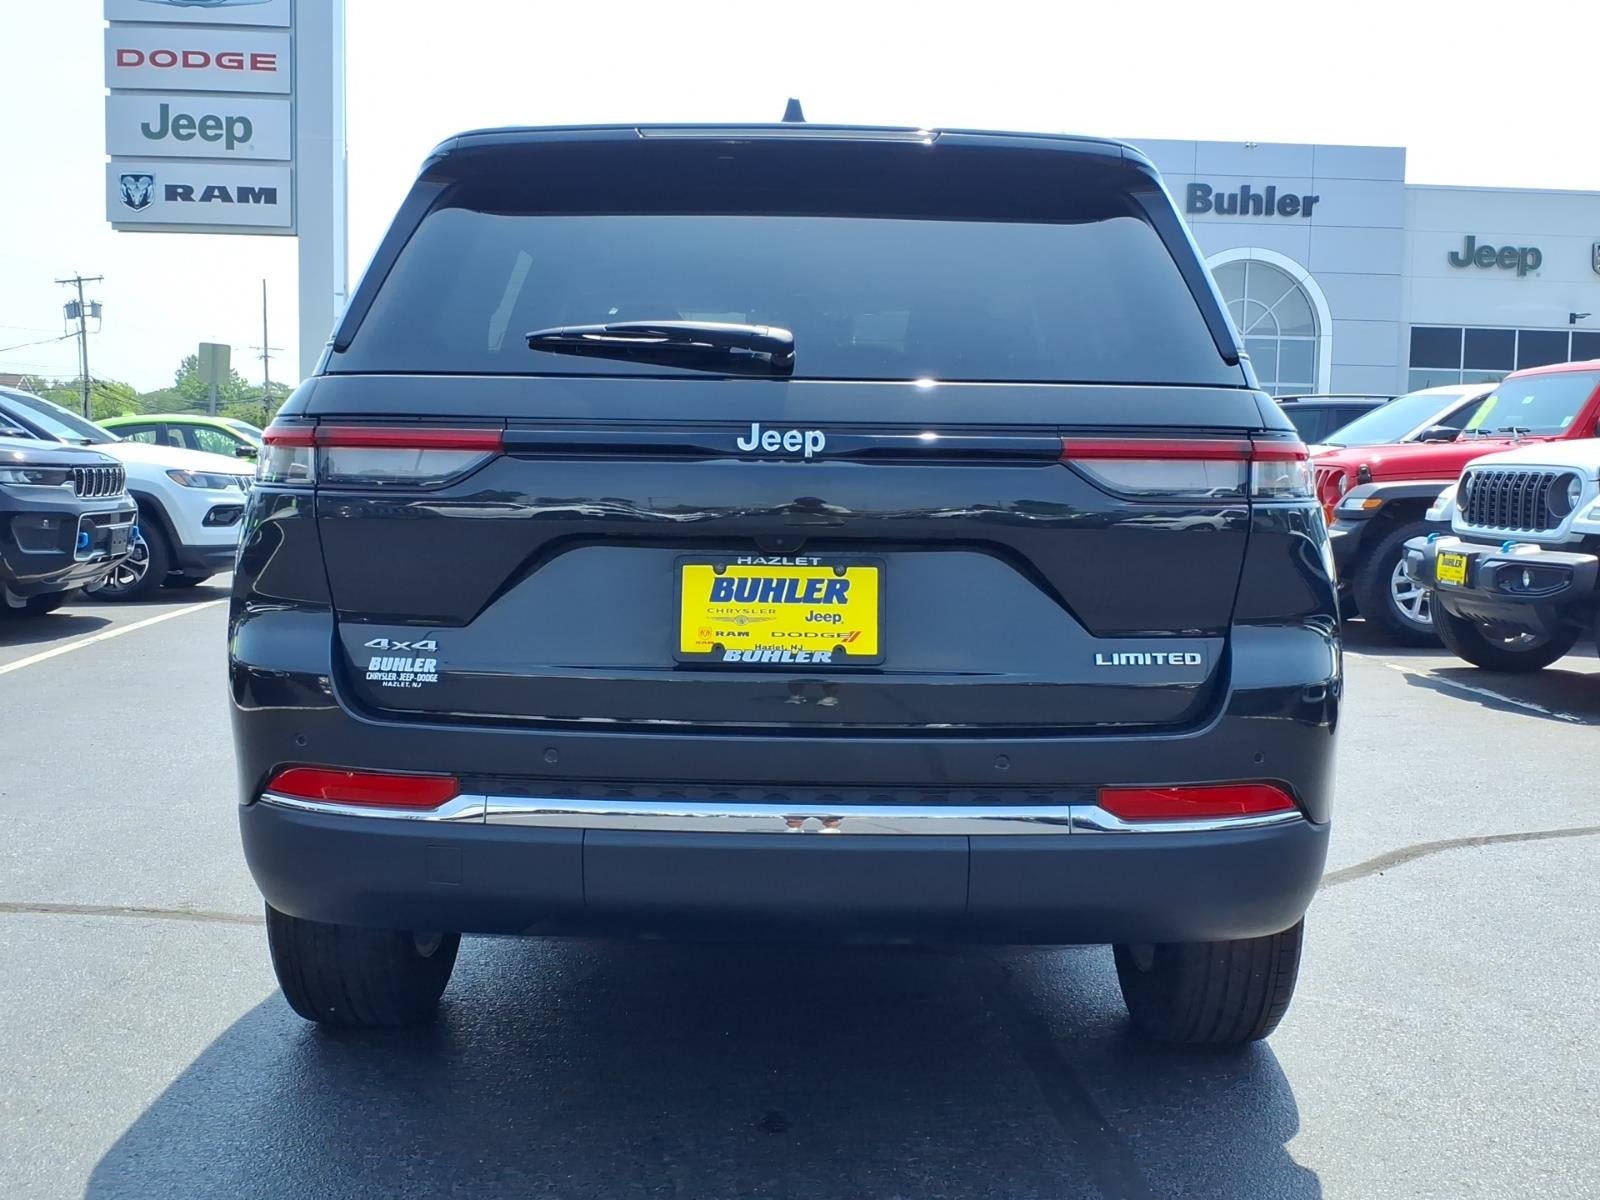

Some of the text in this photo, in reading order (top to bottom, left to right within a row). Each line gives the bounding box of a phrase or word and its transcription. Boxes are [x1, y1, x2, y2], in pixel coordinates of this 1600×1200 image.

[116, 48, 277, 72] DODGE
[140, 103, 253, 151] Jeep
[164, 184, 278, 205] RAM
[1186, 183, 1320, 217] Buhler
[1448, 235, 1542, 276] Jeep
[736, 423, 826, 458] Jeep
[737, 556, 821, 566] HAZLET
[709, 577, 850, 604] BUHLER
[805, 610, 842, 624] Jeep
[771, 631, 848, 639] DODGE
[364, 638, 438, 652] 4x4
[368, 656, 437, 672] BUHLER
[722, 649, 832, 663] BUHLER
[1095, 653, 1201, 665] LIMITED
